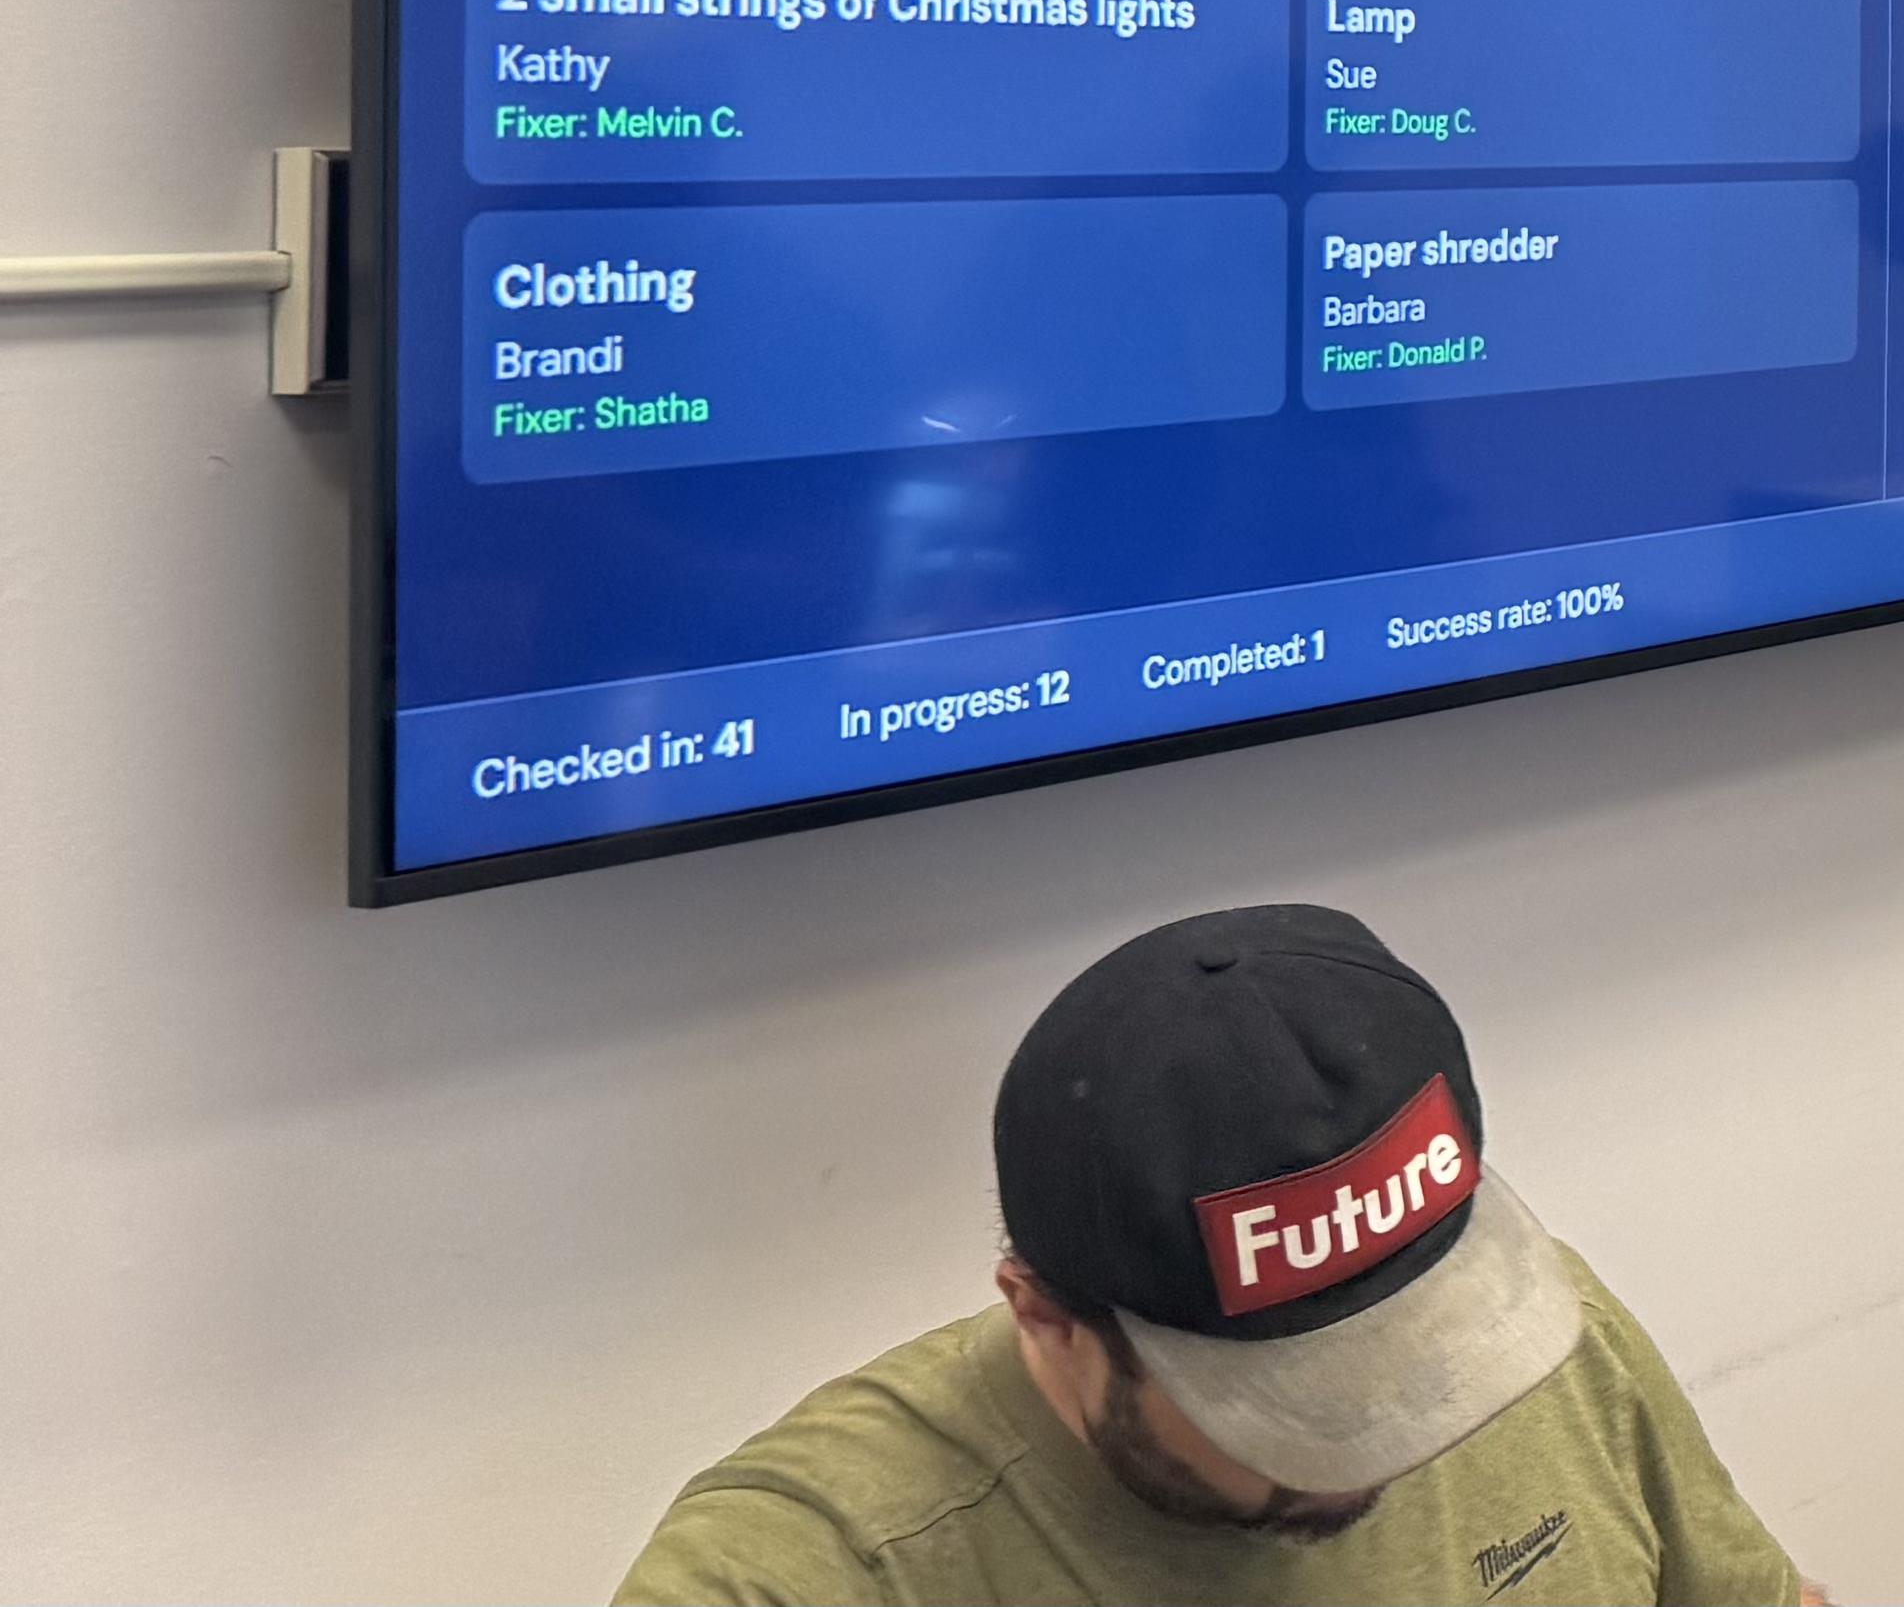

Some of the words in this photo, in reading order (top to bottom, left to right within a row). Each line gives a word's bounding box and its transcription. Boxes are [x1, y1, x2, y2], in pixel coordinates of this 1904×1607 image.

[498, 44, 612, 92] Kathy
[1325, 57, 1378, 89] Sue
[1325, 235, 1418, 278] Paper
[1422, 227, 1559, 266] shredder
[496, 260, 697, 313] Clothing
[1324, 294, 1426, 327] Barbara
[495, 335, 624, 380] Brandi
[495, 402, 585, 436] Fixer:
[595, 392, 709, 430] Shatha
[1387, 610, 1493, 649] Success
[1497, 598, 1552, 630] rate:
[1556, 582, 1624, 620] 100%
[1142, 633, 1306, 690] Completed:
[1311, 629, 1325, 660] 1
[840, 703, 871, 739] In
[880, 682, 1030, 742] progress:
[1036, 669, 1071, 706] 12
[474, 735, 651, 798] Checked
[661, 730, 704, 769] in:
[713, 719, 755, 758] 41
[1231, 1132, 1462, 1287] Future
